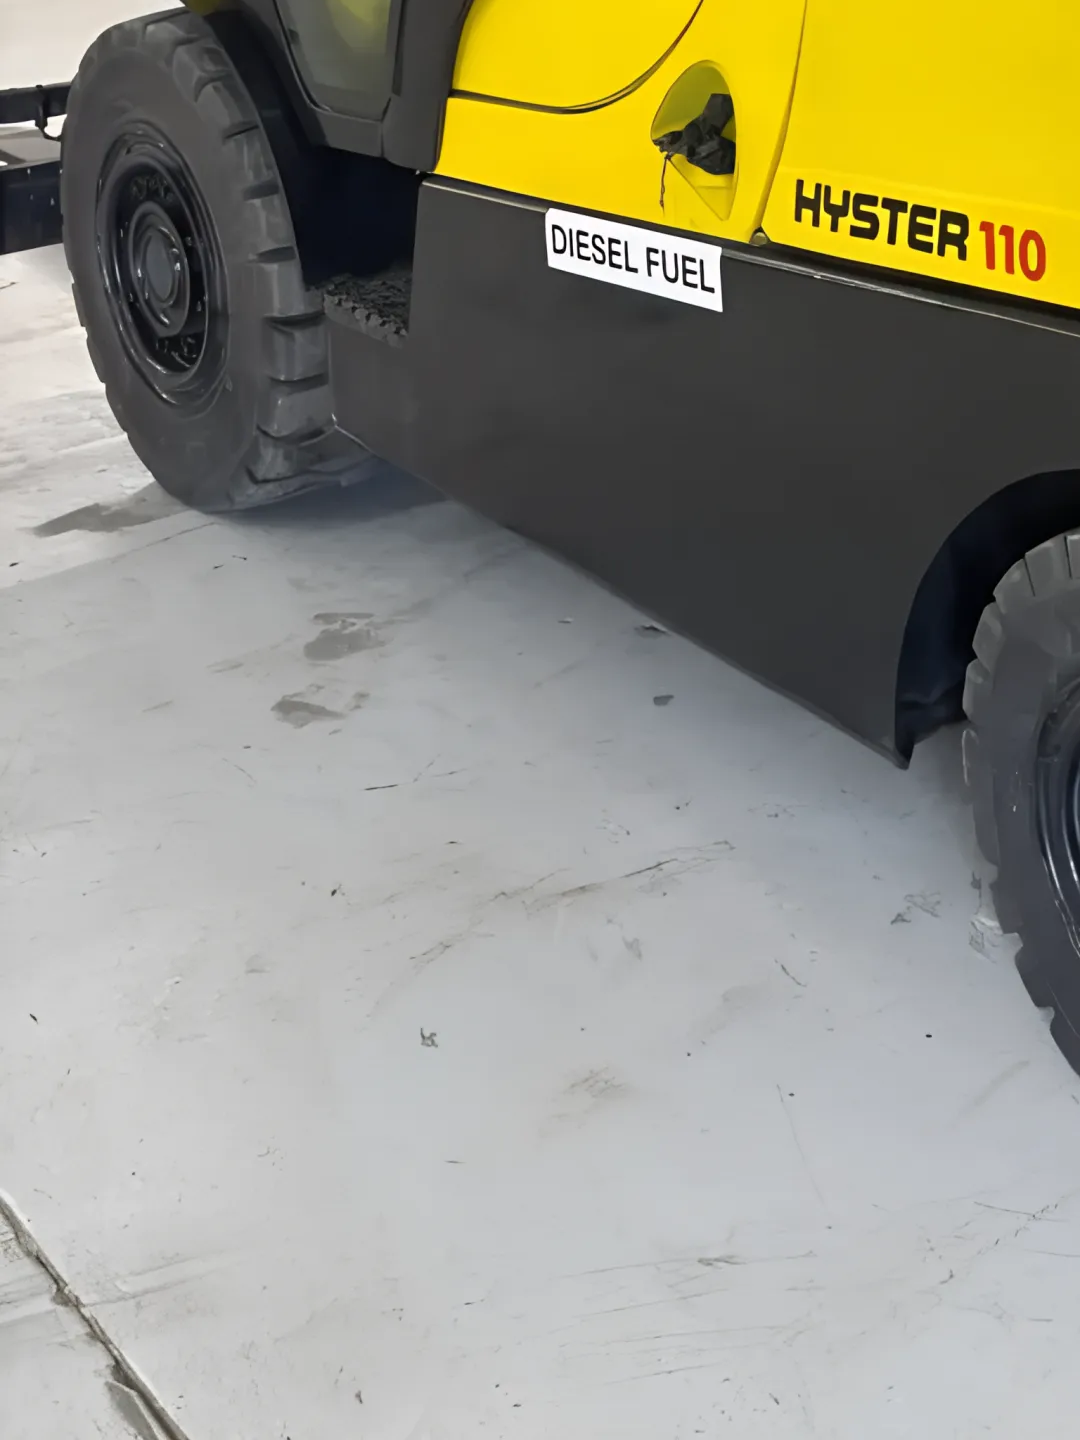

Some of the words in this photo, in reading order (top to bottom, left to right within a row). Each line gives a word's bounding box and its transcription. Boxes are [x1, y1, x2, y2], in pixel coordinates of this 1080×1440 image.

[551, 223, 639, 274] DIESEL
[646, 246, 716, 294] FUEL
[794, 178, 969, 262] HYSTER
[979, 220, 1047, 282] 110
